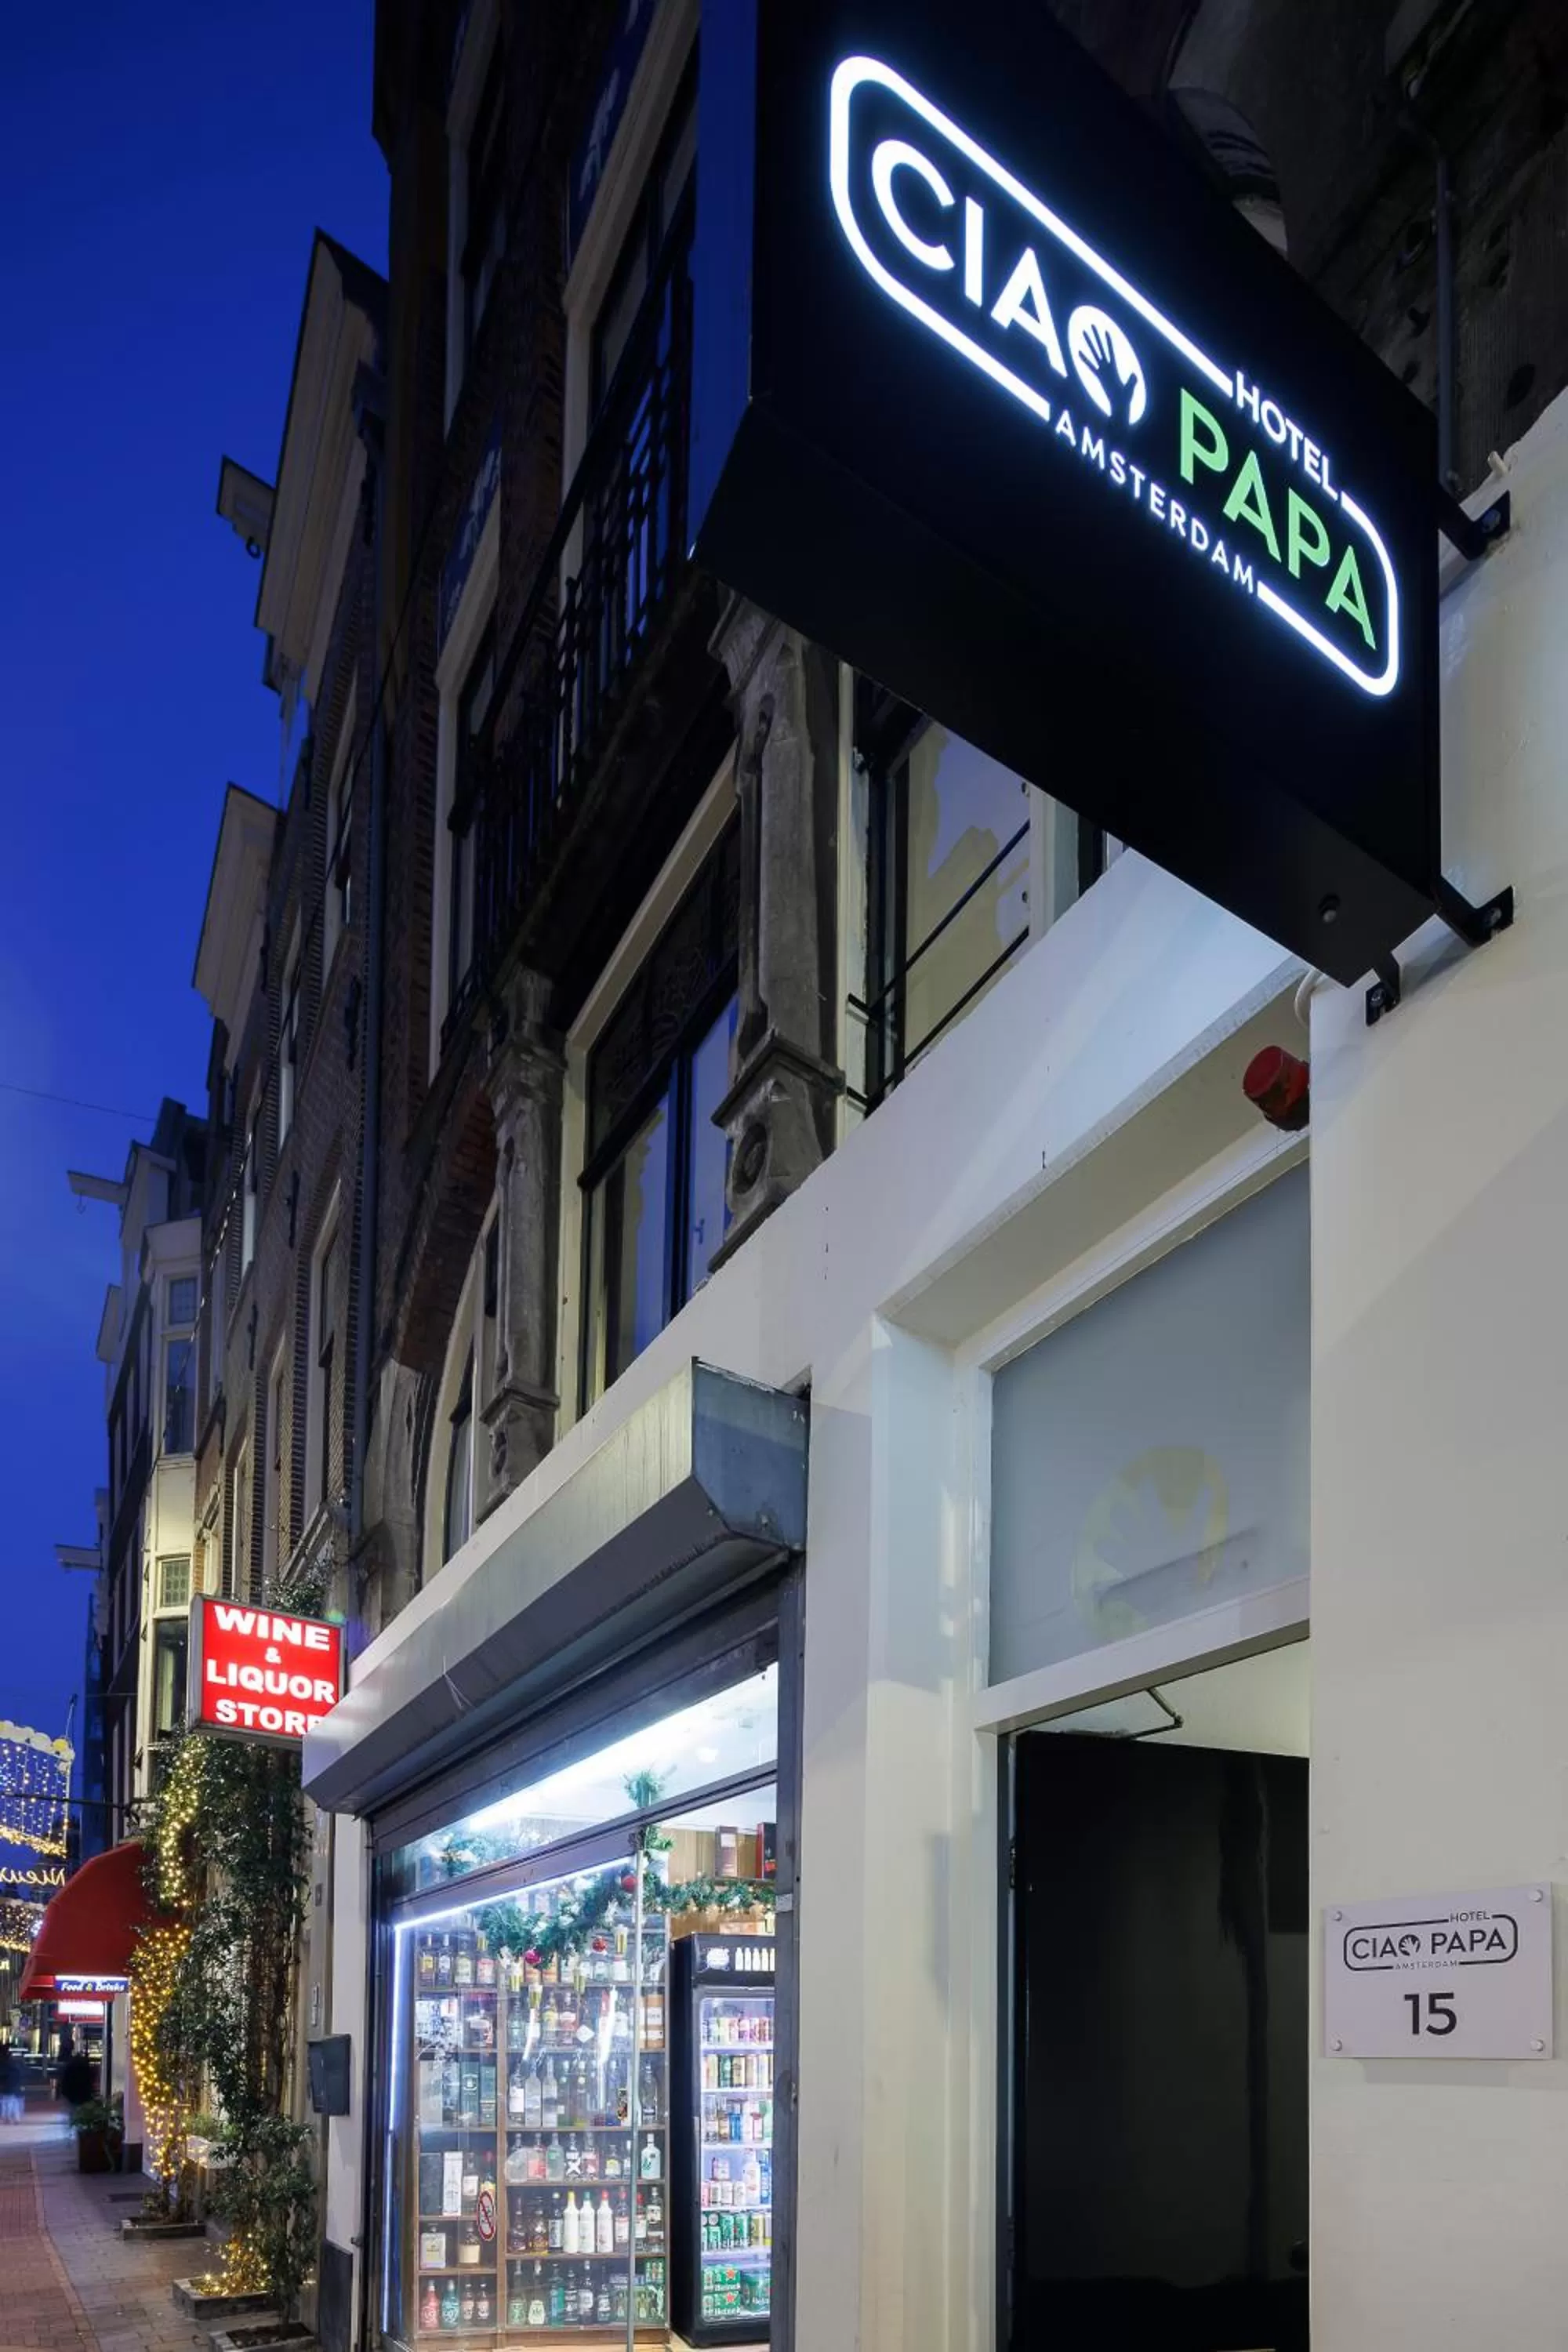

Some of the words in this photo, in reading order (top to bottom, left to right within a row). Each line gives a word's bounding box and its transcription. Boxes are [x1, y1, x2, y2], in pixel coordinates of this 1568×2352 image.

[870, 139, 1147, 426] CIAO
[1181, 390, 1376, 649] PAPA
[1236, 371, 1339, 502] HOTEL
[1055, 409, 1254, 594] AMSTERDAM
[214, 1605, 330, 1651] WINE
[264, 1646, 281, 1664] &
[206, 1658, 336, 1704] LIQUOR
[1450, 1911, 1490, 1922] HOTEL
[1352, 1934, 1421, 1960] CIAO
[1431, 1928, 1507, 1955] PAPA
[1396, 1960, 1457, 1969] AMSTERDAM
[1403, 1991, 1457, 2035] 15
